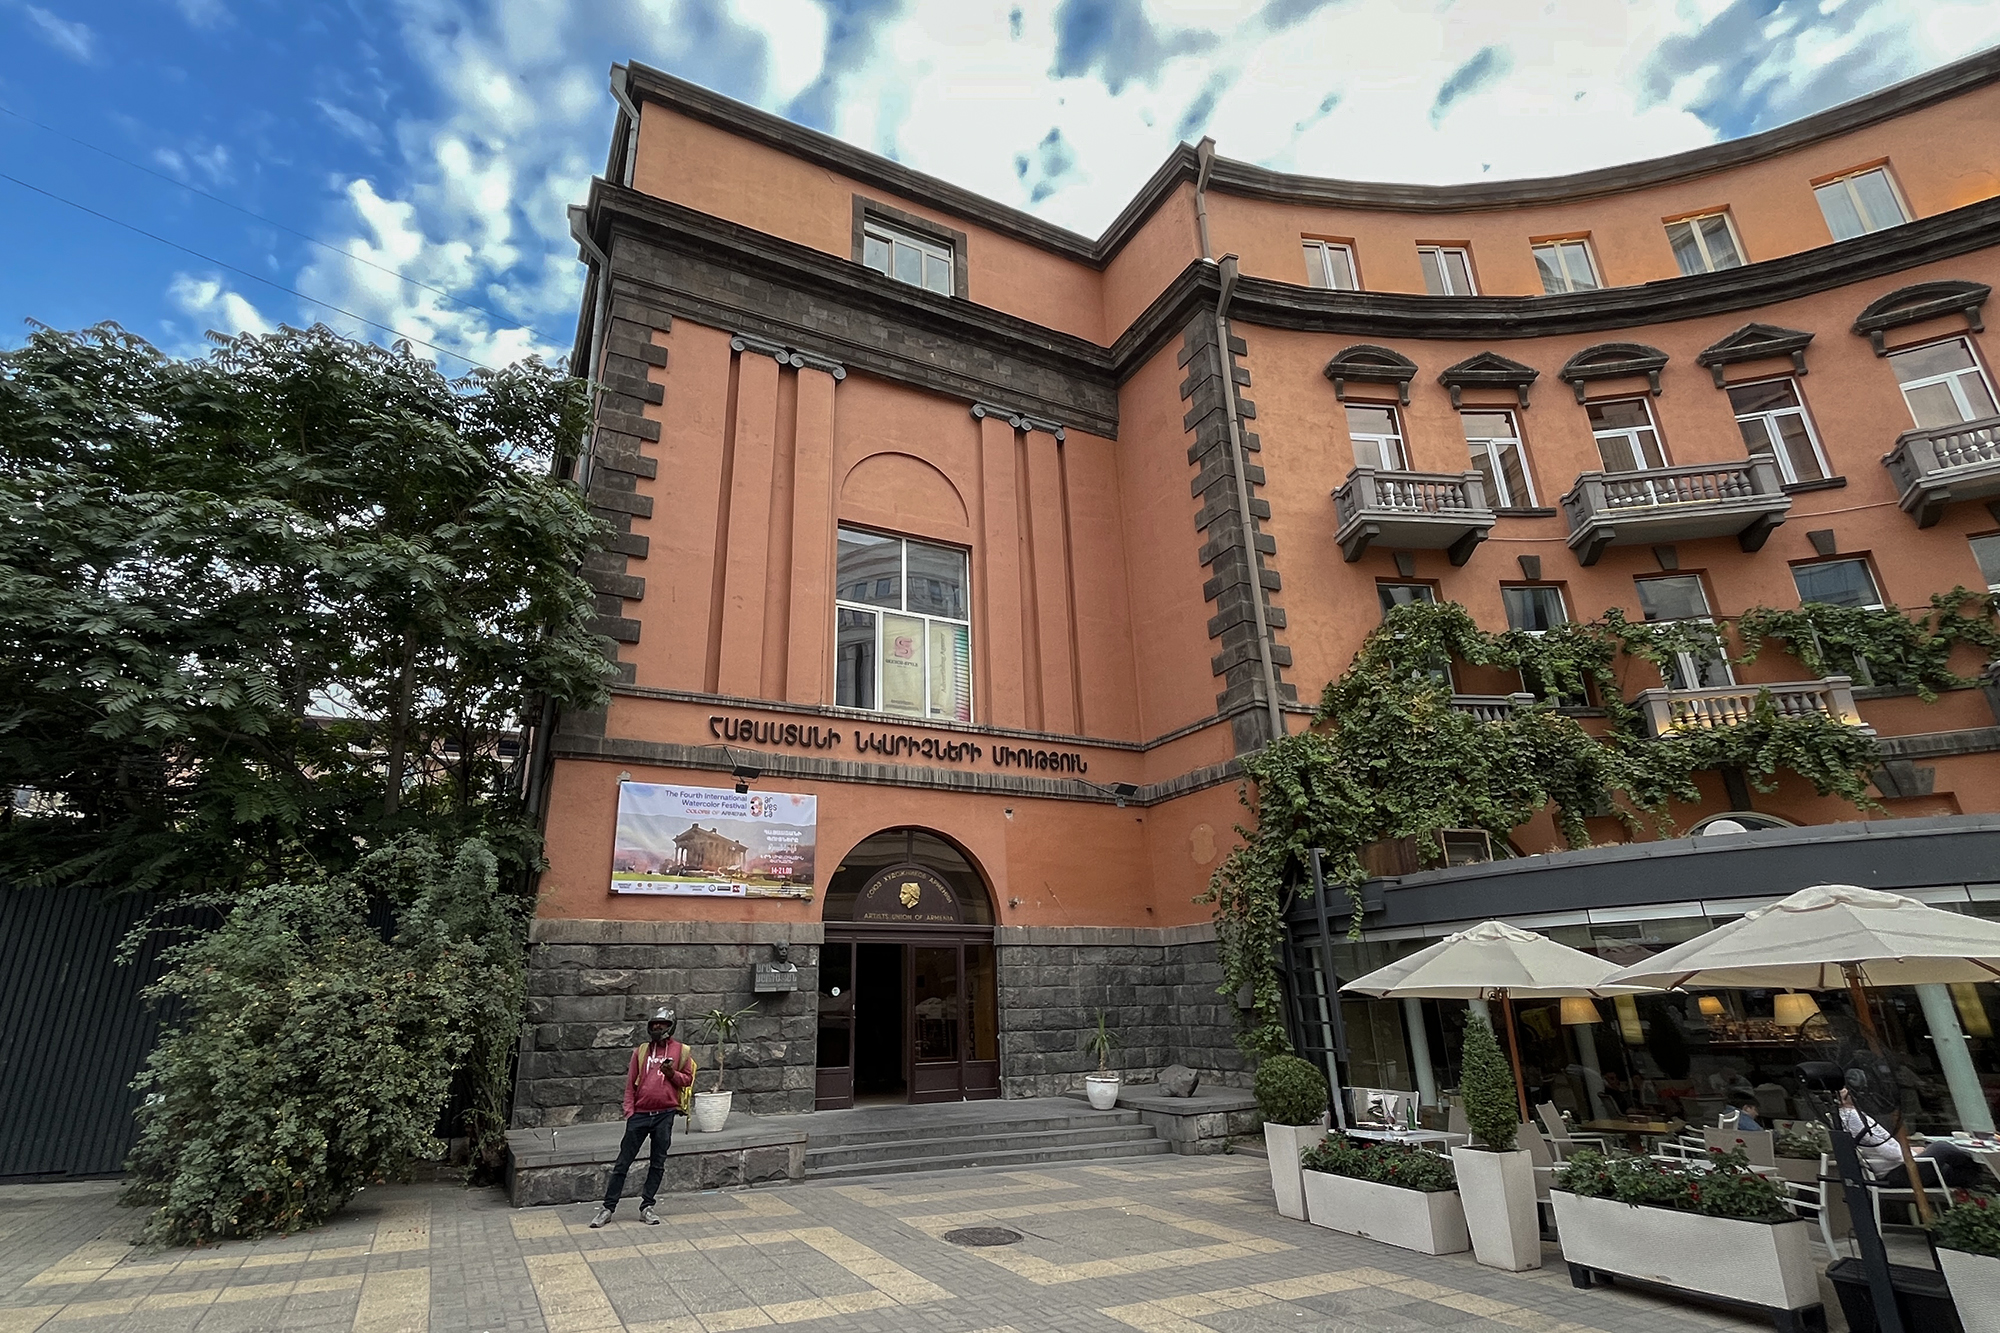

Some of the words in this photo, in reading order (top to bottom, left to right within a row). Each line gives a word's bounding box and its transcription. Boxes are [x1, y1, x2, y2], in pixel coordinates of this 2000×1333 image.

[709, 715, 842, 750] ՀԱՅԱՍՏԱՆԻ
[854, 730, 983, 764] ՆԿԱՐԻՉՆԵՐԻ
[992, 745, 1089, 774] ՄԻՈՒԹՅՈՒՆ
[665, 789, 679, 798] The
[679, 790, 703, 800] Fourth
[704, 792, 748, 802] International
[681, 799, 720, 809] Watercolor
[721, 801, 748, 810] Festival
[721, 810, 747, 818] ARMENIA
[866, 881, 883, 899] СОЮЗ
[883, 870, 927, 883] ХУДОЖНИКОВ
[928, 877, 953, 904] АРМЕНИИ
[863, 912, 889, 920] ARTISTS
[891, 913, 912, 921] UNION
[914, 913, 923, 921] OF
[926, 914, 954, 922] ARMENIA
